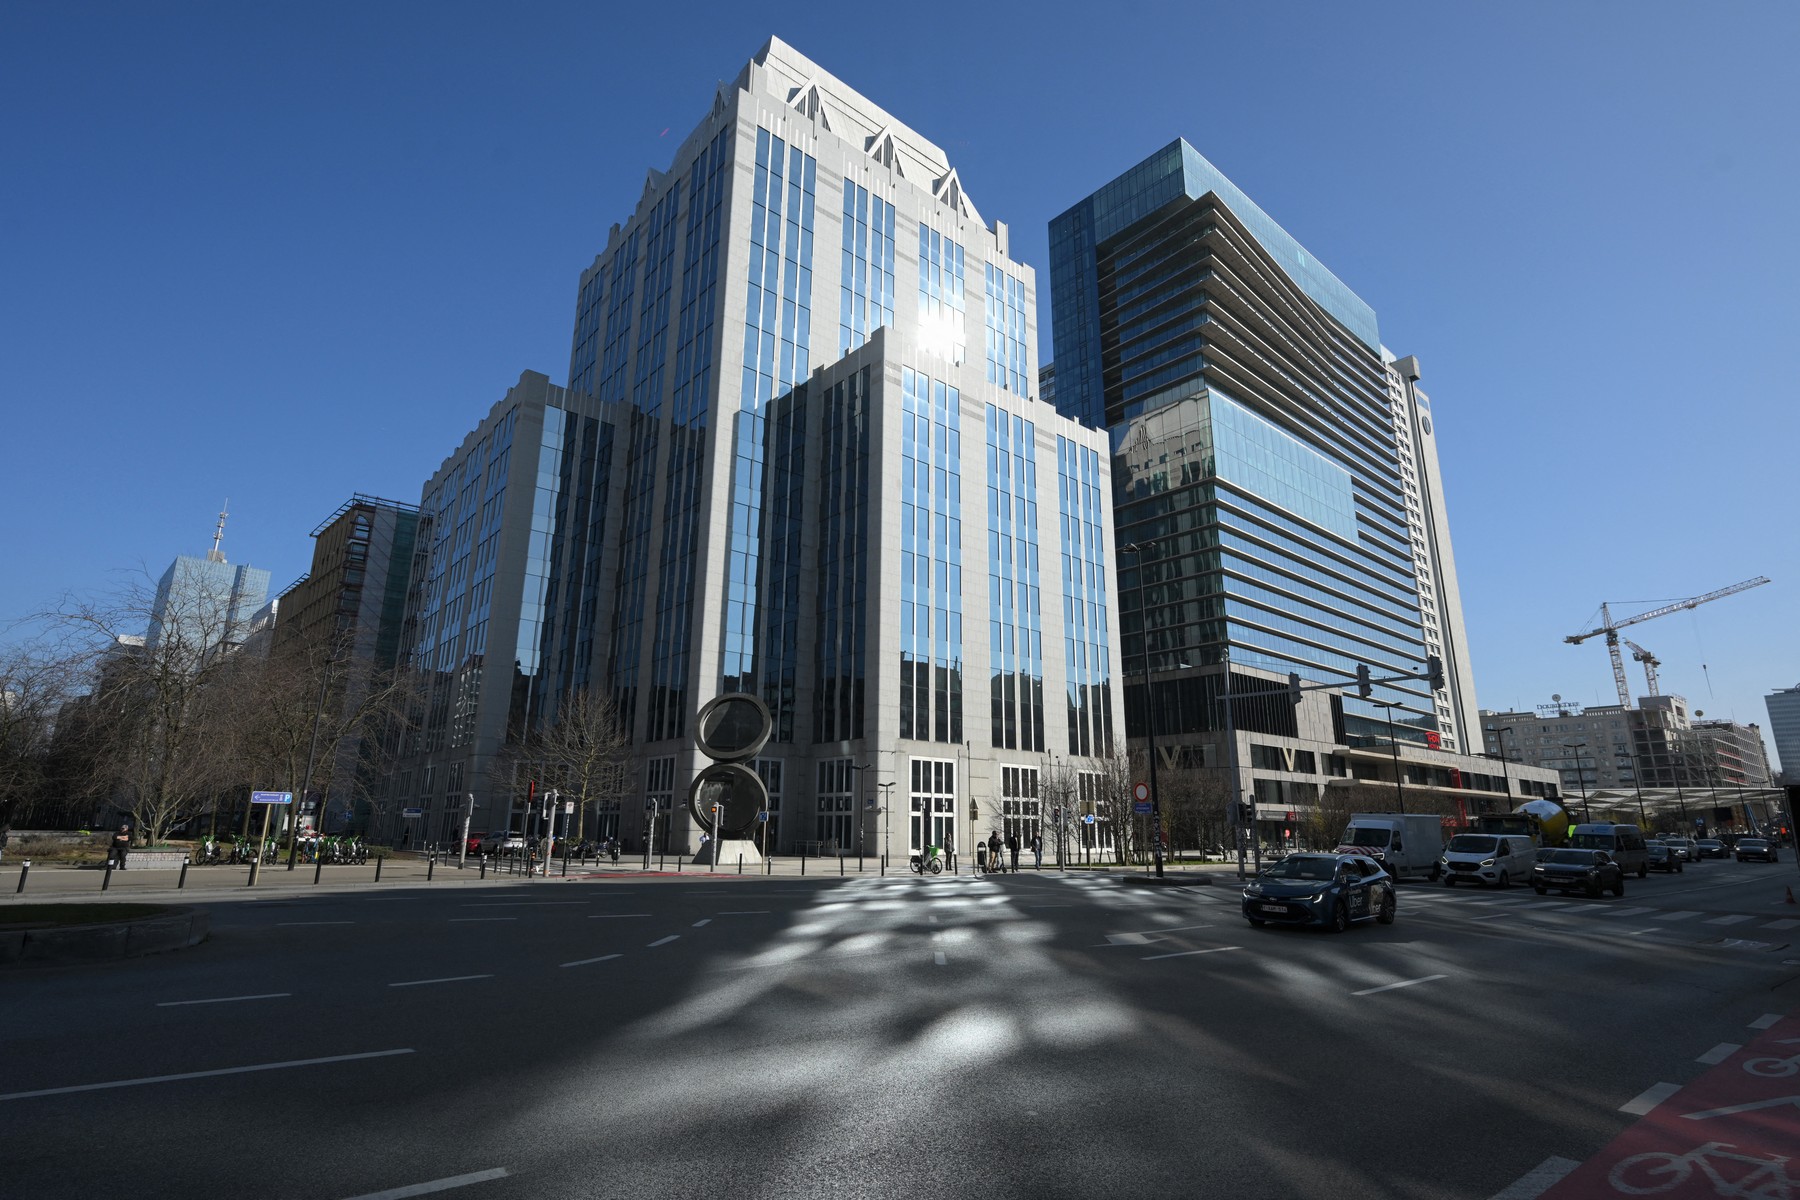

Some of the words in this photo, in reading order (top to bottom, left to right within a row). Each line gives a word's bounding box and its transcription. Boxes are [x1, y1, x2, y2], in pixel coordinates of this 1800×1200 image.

[1158, 745, 1182, 769] V
[1282, 747, 1296, 771] V
[284, 794, 291, 802] P
[1349, 896, 1363, 908] Uber
